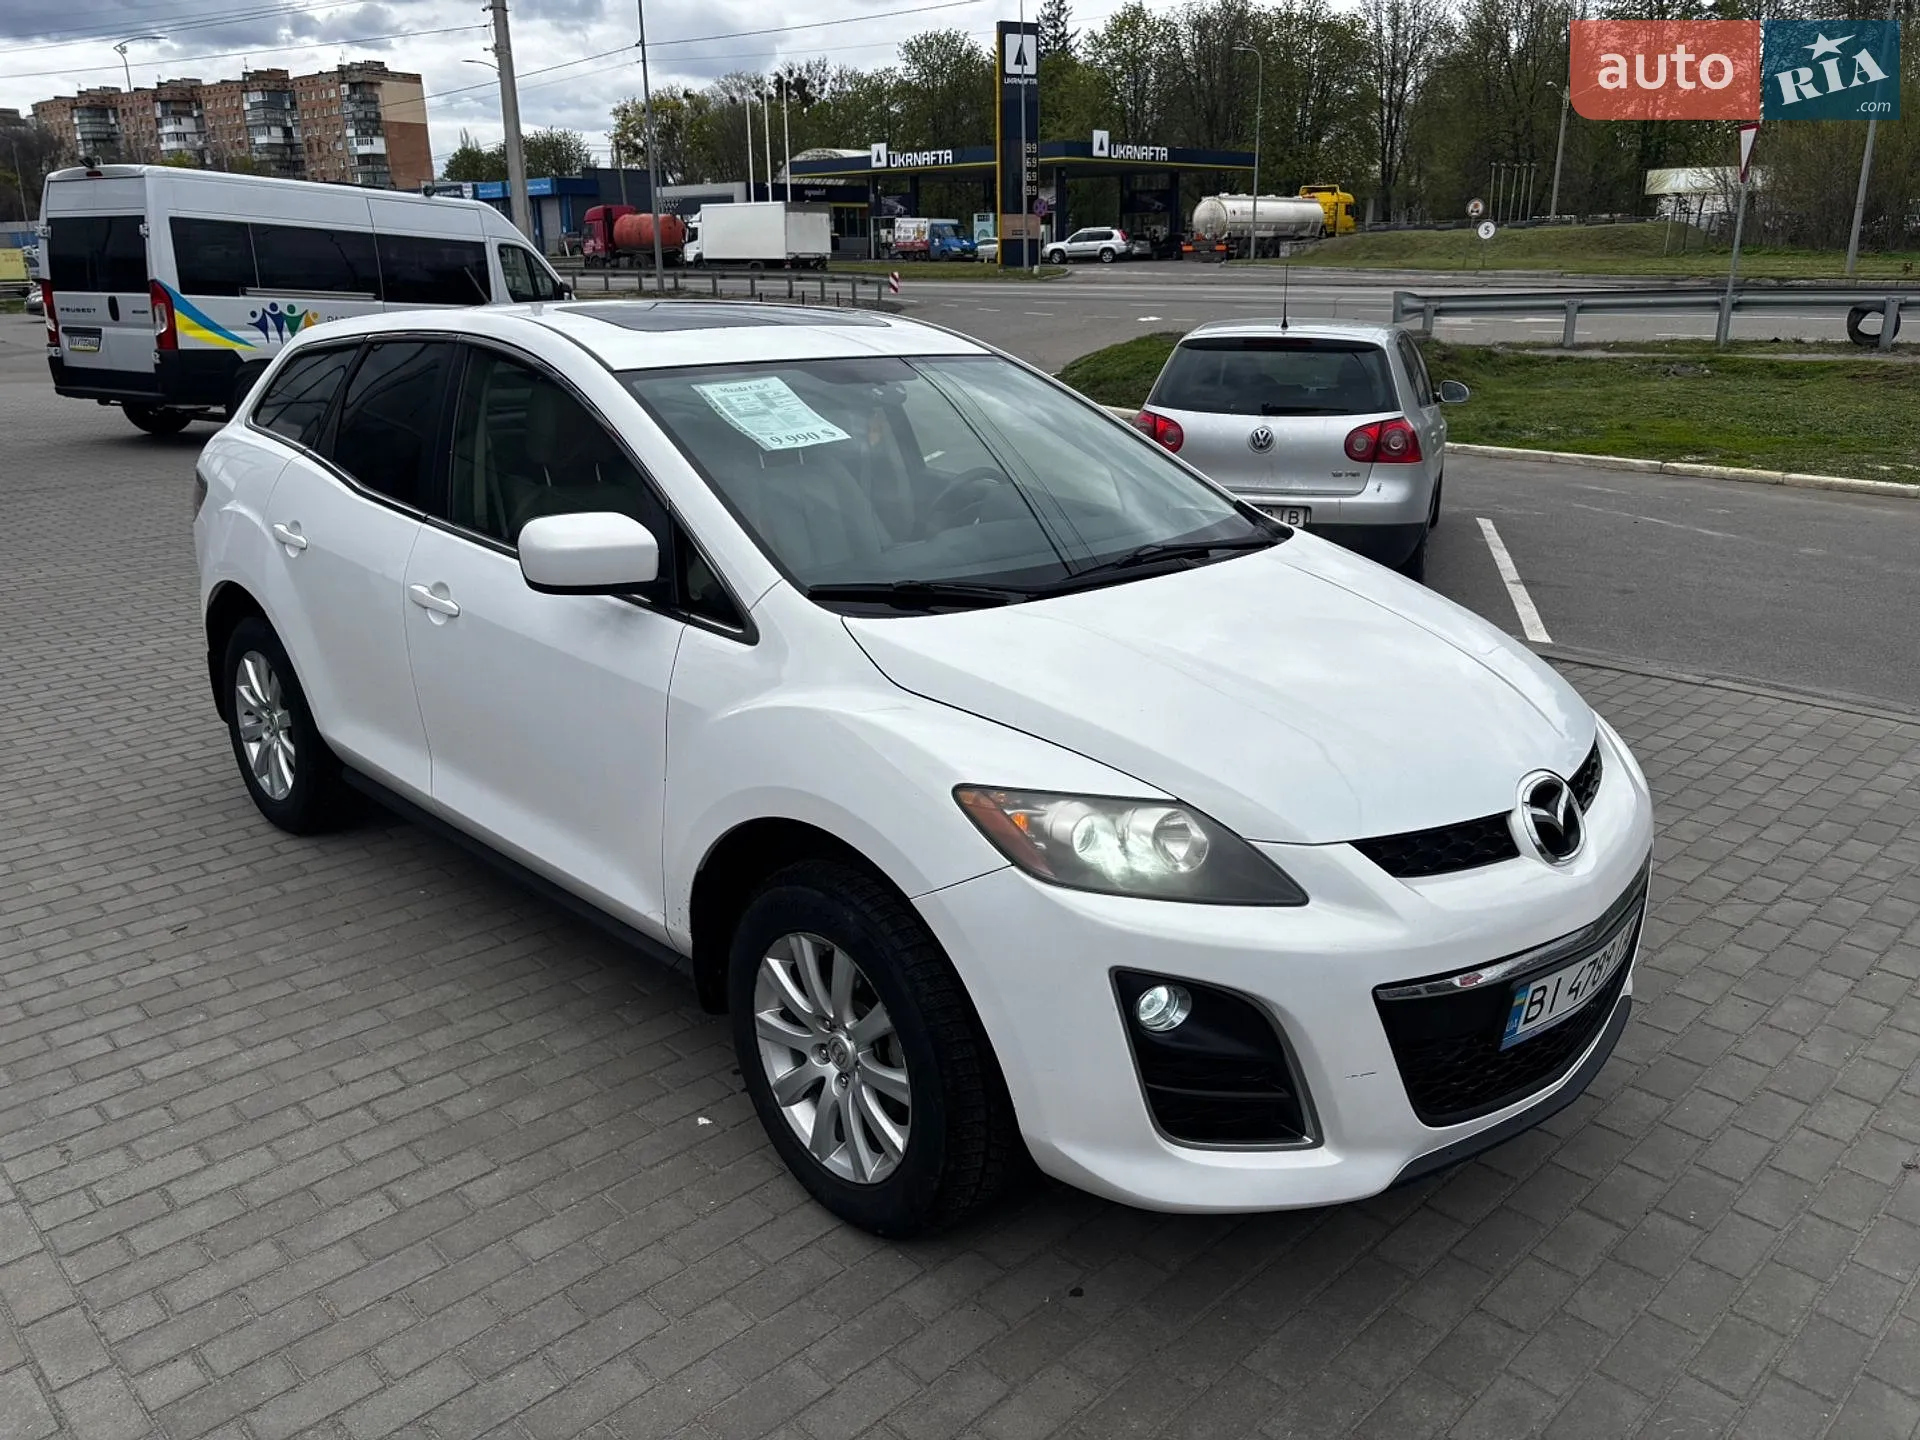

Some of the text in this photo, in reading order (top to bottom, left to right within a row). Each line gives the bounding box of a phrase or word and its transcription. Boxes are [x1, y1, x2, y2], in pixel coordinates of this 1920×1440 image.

[1004, 77, 1037, 85] UKRNFTA
[889, 149, 953, 168] UKRNAFTA
[1110, 143, 1168, 161] UKRNAFTA
[770, 436, 783, 446] 9
[785, 431, 821, 445] 990
[821, 427, 837, 438] $
[1522, 977, 1562, 1025] BI
